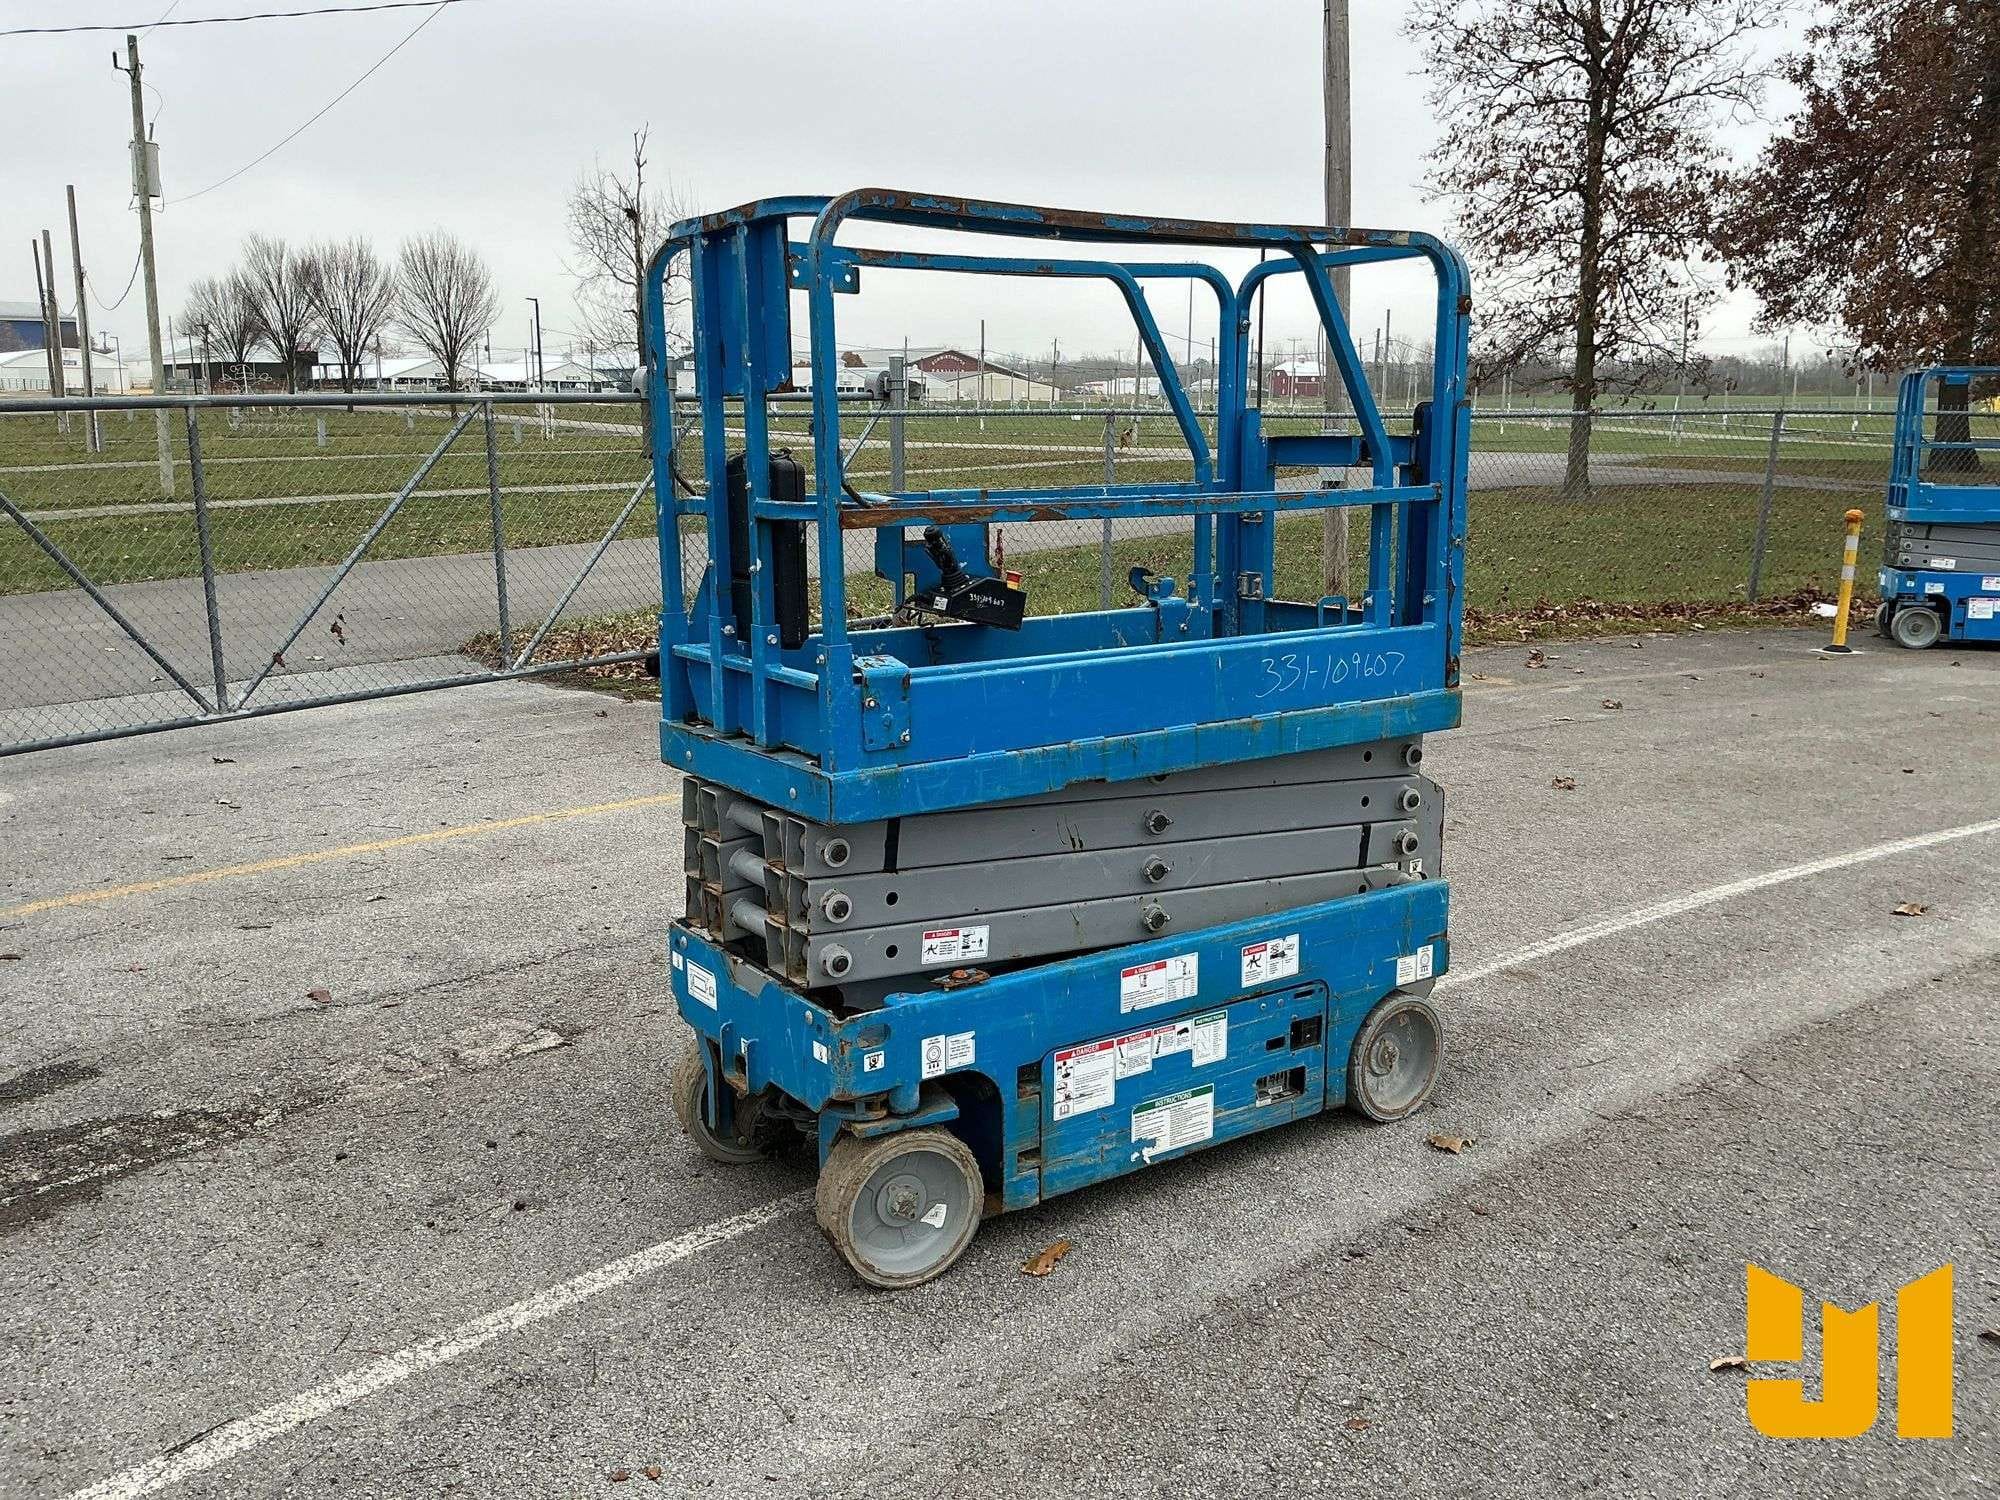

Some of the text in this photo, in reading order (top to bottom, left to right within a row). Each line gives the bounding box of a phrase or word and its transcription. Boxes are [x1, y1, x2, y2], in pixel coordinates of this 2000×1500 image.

[1255, 651, 1405, 698] 331-109607
[1075, 1044, 1101, 1056] DANGER
[1154, 1091, 1193, 1107] INSTRUCTIONS
